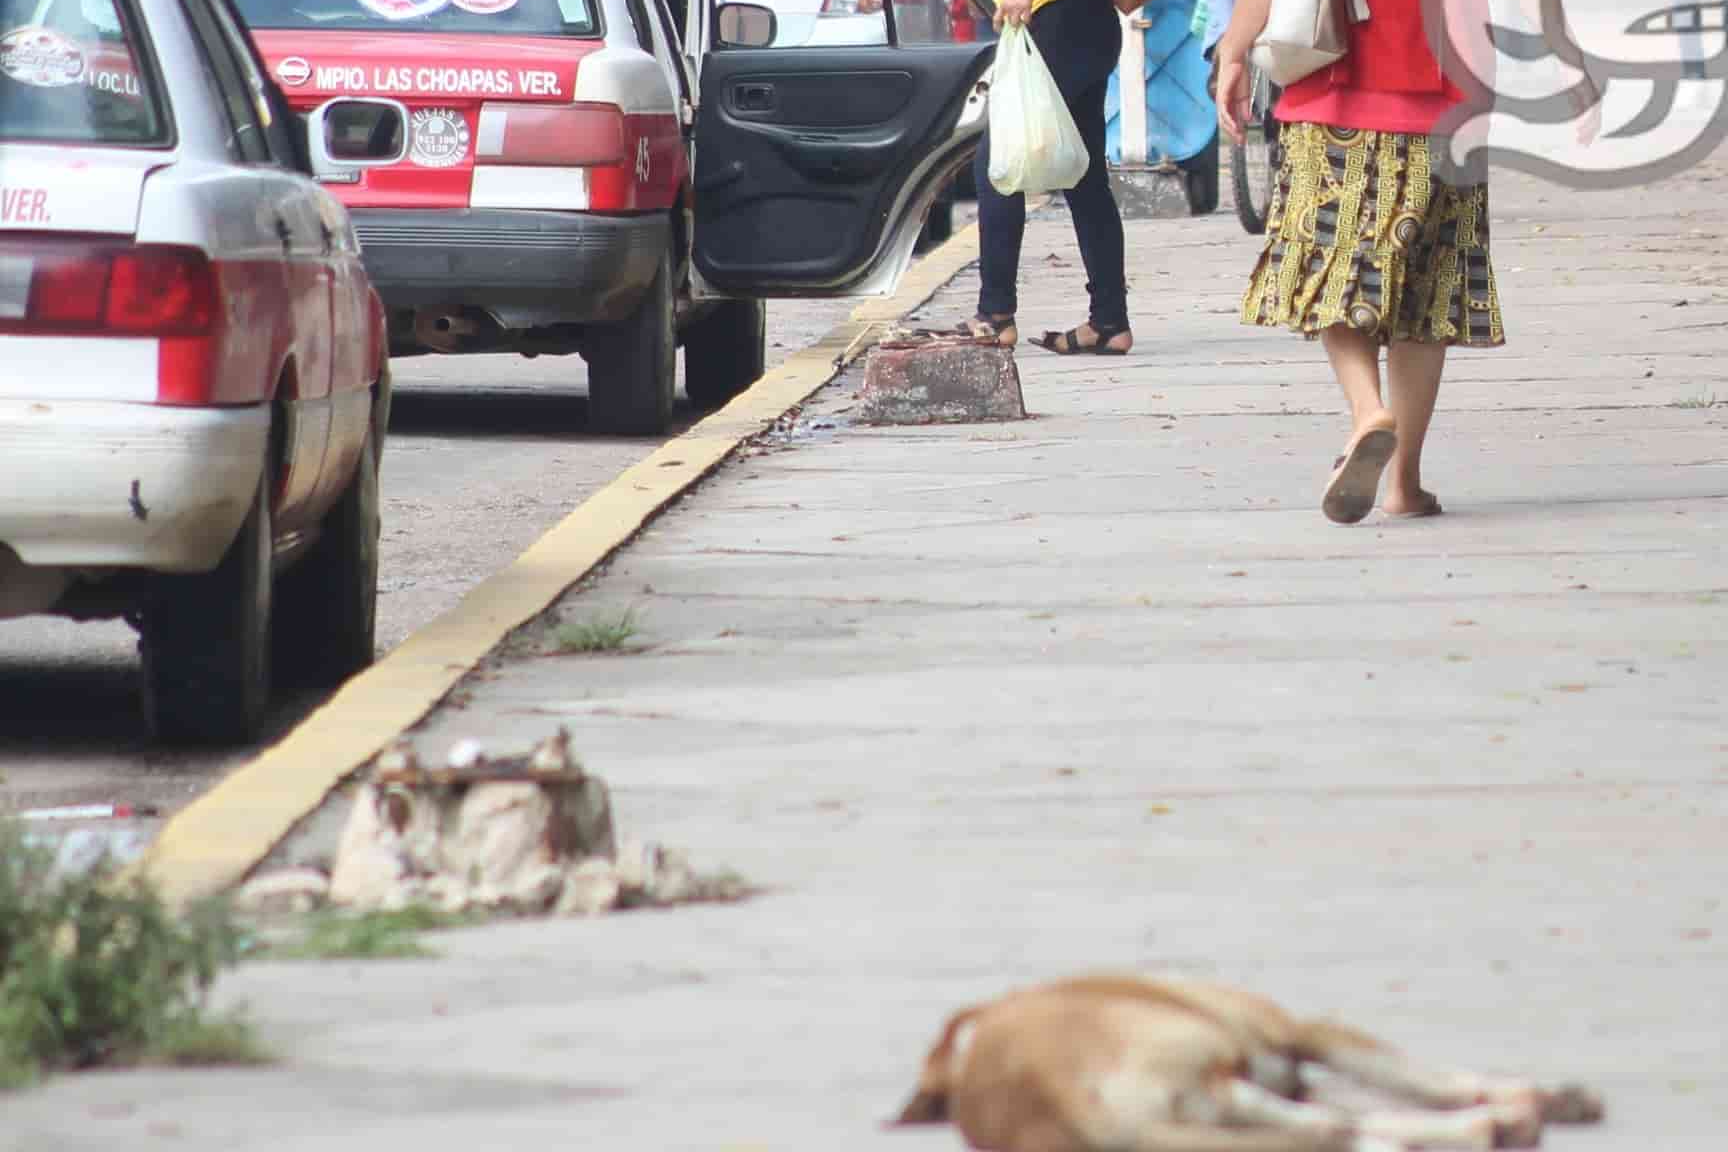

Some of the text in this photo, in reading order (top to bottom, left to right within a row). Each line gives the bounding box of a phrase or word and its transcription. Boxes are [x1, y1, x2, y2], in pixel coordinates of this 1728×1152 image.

[316, 65, 369, 91] MPIO.
[373, 67, 413, 92] LAS
[519, 70, 562, 96] VER.
[635, 135, 650, 184] 45
[2, 188, 51, 223] VER.
